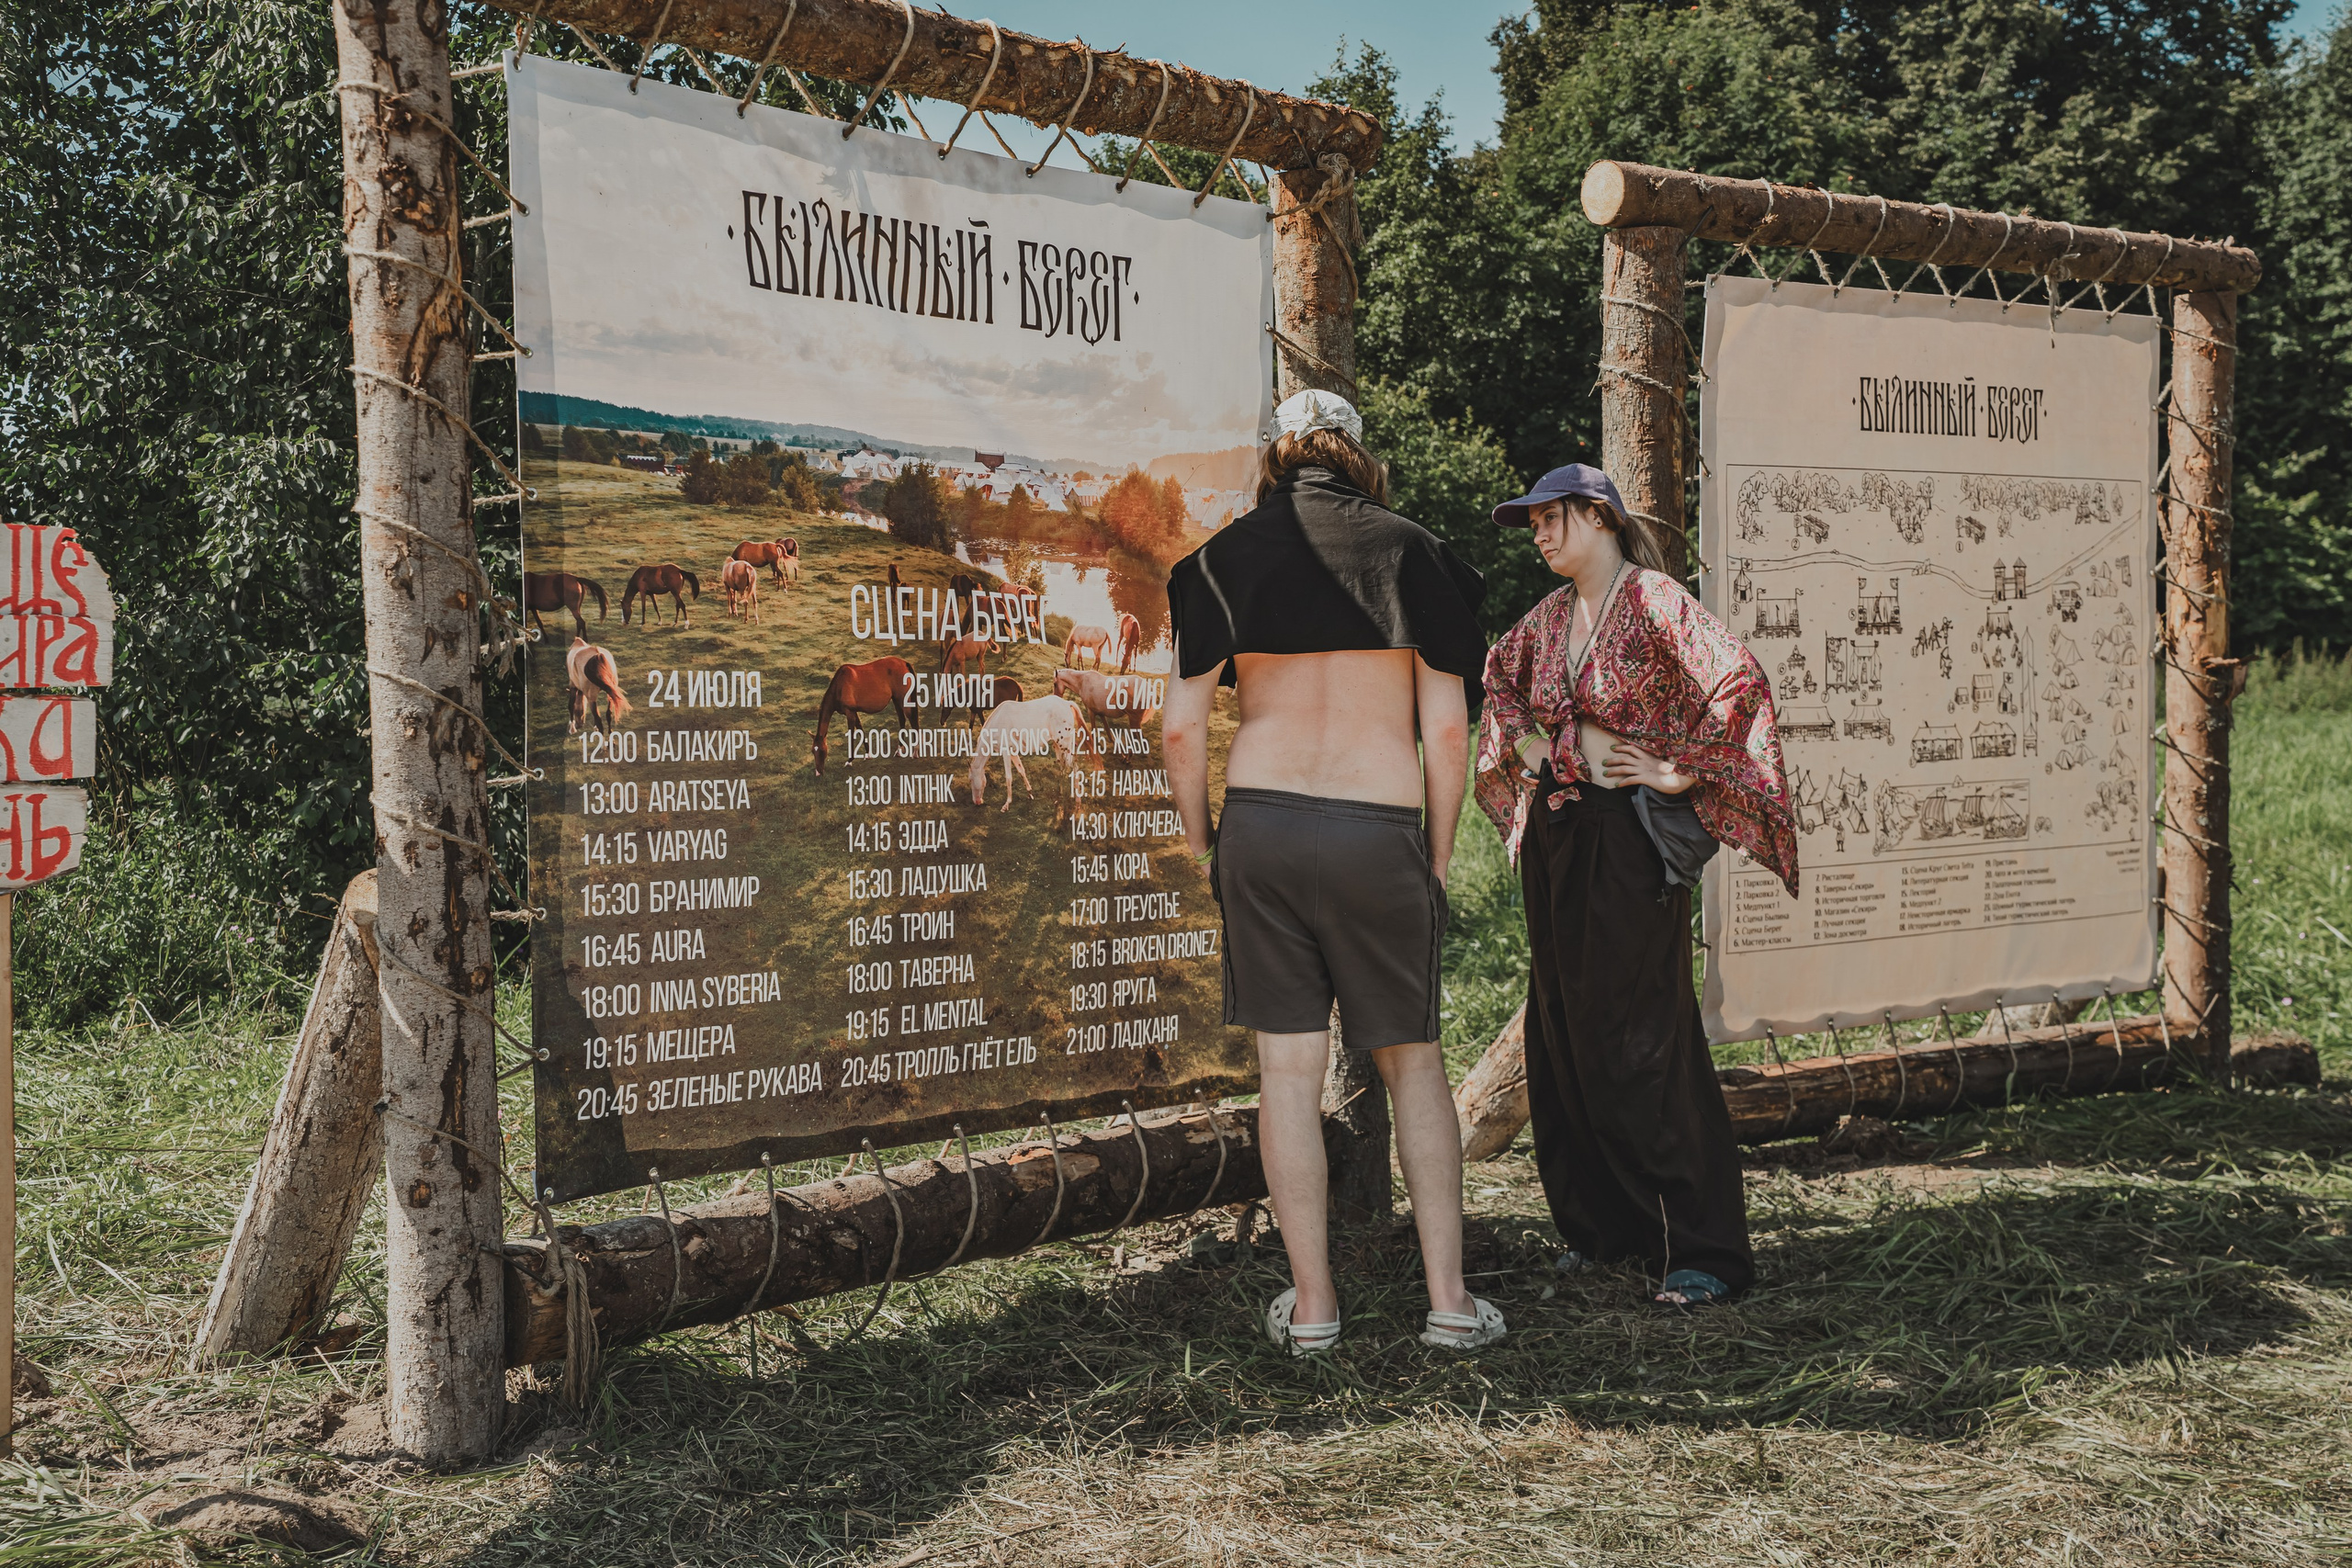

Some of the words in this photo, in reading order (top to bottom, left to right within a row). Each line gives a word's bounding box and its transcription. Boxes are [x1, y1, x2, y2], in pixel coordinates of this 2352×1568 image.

[742, 190, 993, 323] БЫЛИННЫЙ
[1018, 241, 1132, 345] БЕРЕГ
[1987, 386, 2043, 444] БЕРЕГ
[851, 584, 962, 646] СЦЕНА
[972, 591, 1047, 645] БЕРЕГ
[648, 671, 681, 708] 24
[687, 670, 762, 708] ИЮЛЯ
[903, 672, 929, 708] 25
[934, 673, 994, 709] ИЮЛЯ
[1104, 678, 1128, 710] 26
[1133, 678, 1165, 710] ИЮ
[579, 730, 638, 764] 12:00
[647, 728, 758, 762] БАЛАКИРЪ
[845, 729, 891, 759] 12:00
[899, 728, 978, 758] SPIRITUAL
[980, 728, 1050, 756] SEASONS
[1071, 728, 1106, 755] 12:15
[1110, 728, 1149, 754] ЖАБЪ
[580, 780, 639, 815] 13:00
[648, 777, 750, 812] ARATSEYA
[846, 776, 891, 806] 13:00
[899, 774, 956, 804] INTIHIK
[1069, 771, 1105, 797] 13:15
[1113, 770, 1173, 797] НАВАЖД
[846, 822, 891, 852] 14:15
[899, 820, 949, 853] ЭДДА
[1069, 812, 1106, 840] 14:30
[1114, 810, 1185, 838] КЛЮЧЕВА
[581, 830, 638, 865] 14:15
[648, 828, 728, 863] VARYAG
[847, 869, 892, 899] 15:30
[899, 863, 988, 898] ЛАДУШКА
[1070, 856, 1108, 884] 15:45
[1114, 852, 1150, 880] КОРА
[1744, 878, 1774, 888] Парковка
[1822, 873, 1855, 882] Ристалище
[581, 882, 639, 917] 15:30
[650, 875, 760, 912] БРАНИМИР
[1744, 891, 1774, 900] Парковка
[1822, 896, 1858, 905] Историчная
[1860, 893, 1885, 902] торговля
[1823, 885, 1847, 894] Таверна
[1848, 883, 1874, 892] «Секира»
[1070, 897, 1108, 926] 17:00
[1114, 892, 1182, 921] ТРЕУСТЬЕ
[1743, 915, 1763, 924] Сцена
[1765, 912, 1790, 921] Былина
[1744, 902, 1775, 912] Медпункт
[1821, 919, 1844, 928] Лучная
[1845, 918, 1866, 926] секция
[1824, 908, 1849, 917] Магазин
[1850, 906, 1877, 915] «Секира»
[847, 917, 892, 946] 16:45
[900, 912, 955, 942] ТРОИН
[1741, 936, 1792, 947] Мастер-классы
[1742, 927, 1762, 935] Сцена
[1764, 925, 1782, 933] Берег
[1823, 931, 1838, 940] Зона
[1838, 929, 1867, 939] досмотра
[581, 932, 640, 967] 16:45
[650, 929, 706, 962] AURA
[1070, 940, 1106, 969] 18:15
[1113, 934, 1166, 964] BROKEN
[1168, 930, 1218, 960] DRONEZ
[847, 964, 892, 994] 18:00
[900, 954, 975, 989] ТАВЕРНА
[581, 984, 640, 1019] 18:00
[650, 977, 697, 1013] INNA
[702, 972, 781, 1009] SYBERIA
[1070, 984, 1107, 1012] 19:30
[1113, 976, 1157, 1008] ЯРУГА
[845, 1010, 889, 1041] 19:15
[900, 1005, 920, 1034] EL
[923, 998, 988, 1032] MENTAL
[1066, 1024, 1106, 1055] 21:00
[1111, 1014, 1179, 1050] ЛАДКАНЯ
[582, 1035, 638, 1070] 19:15
[647, 1025, 736, 1066] МЕЩЕРА
[841, 1053, 891, 1088] 20:45
[894, 1046, 959, 1082] ТРОЛЛЬ
[961, 1039, 1004, 1075] ГНЁТ
[1006, 1035, 1037, 1067] ЕЛЬ
[577, 1085, 638, 1122] 20:45
[647, 1070, 745, 1113] ЗЕЛЕНЫЕ
[747, 1062, 822, 1100] РУКАВА
